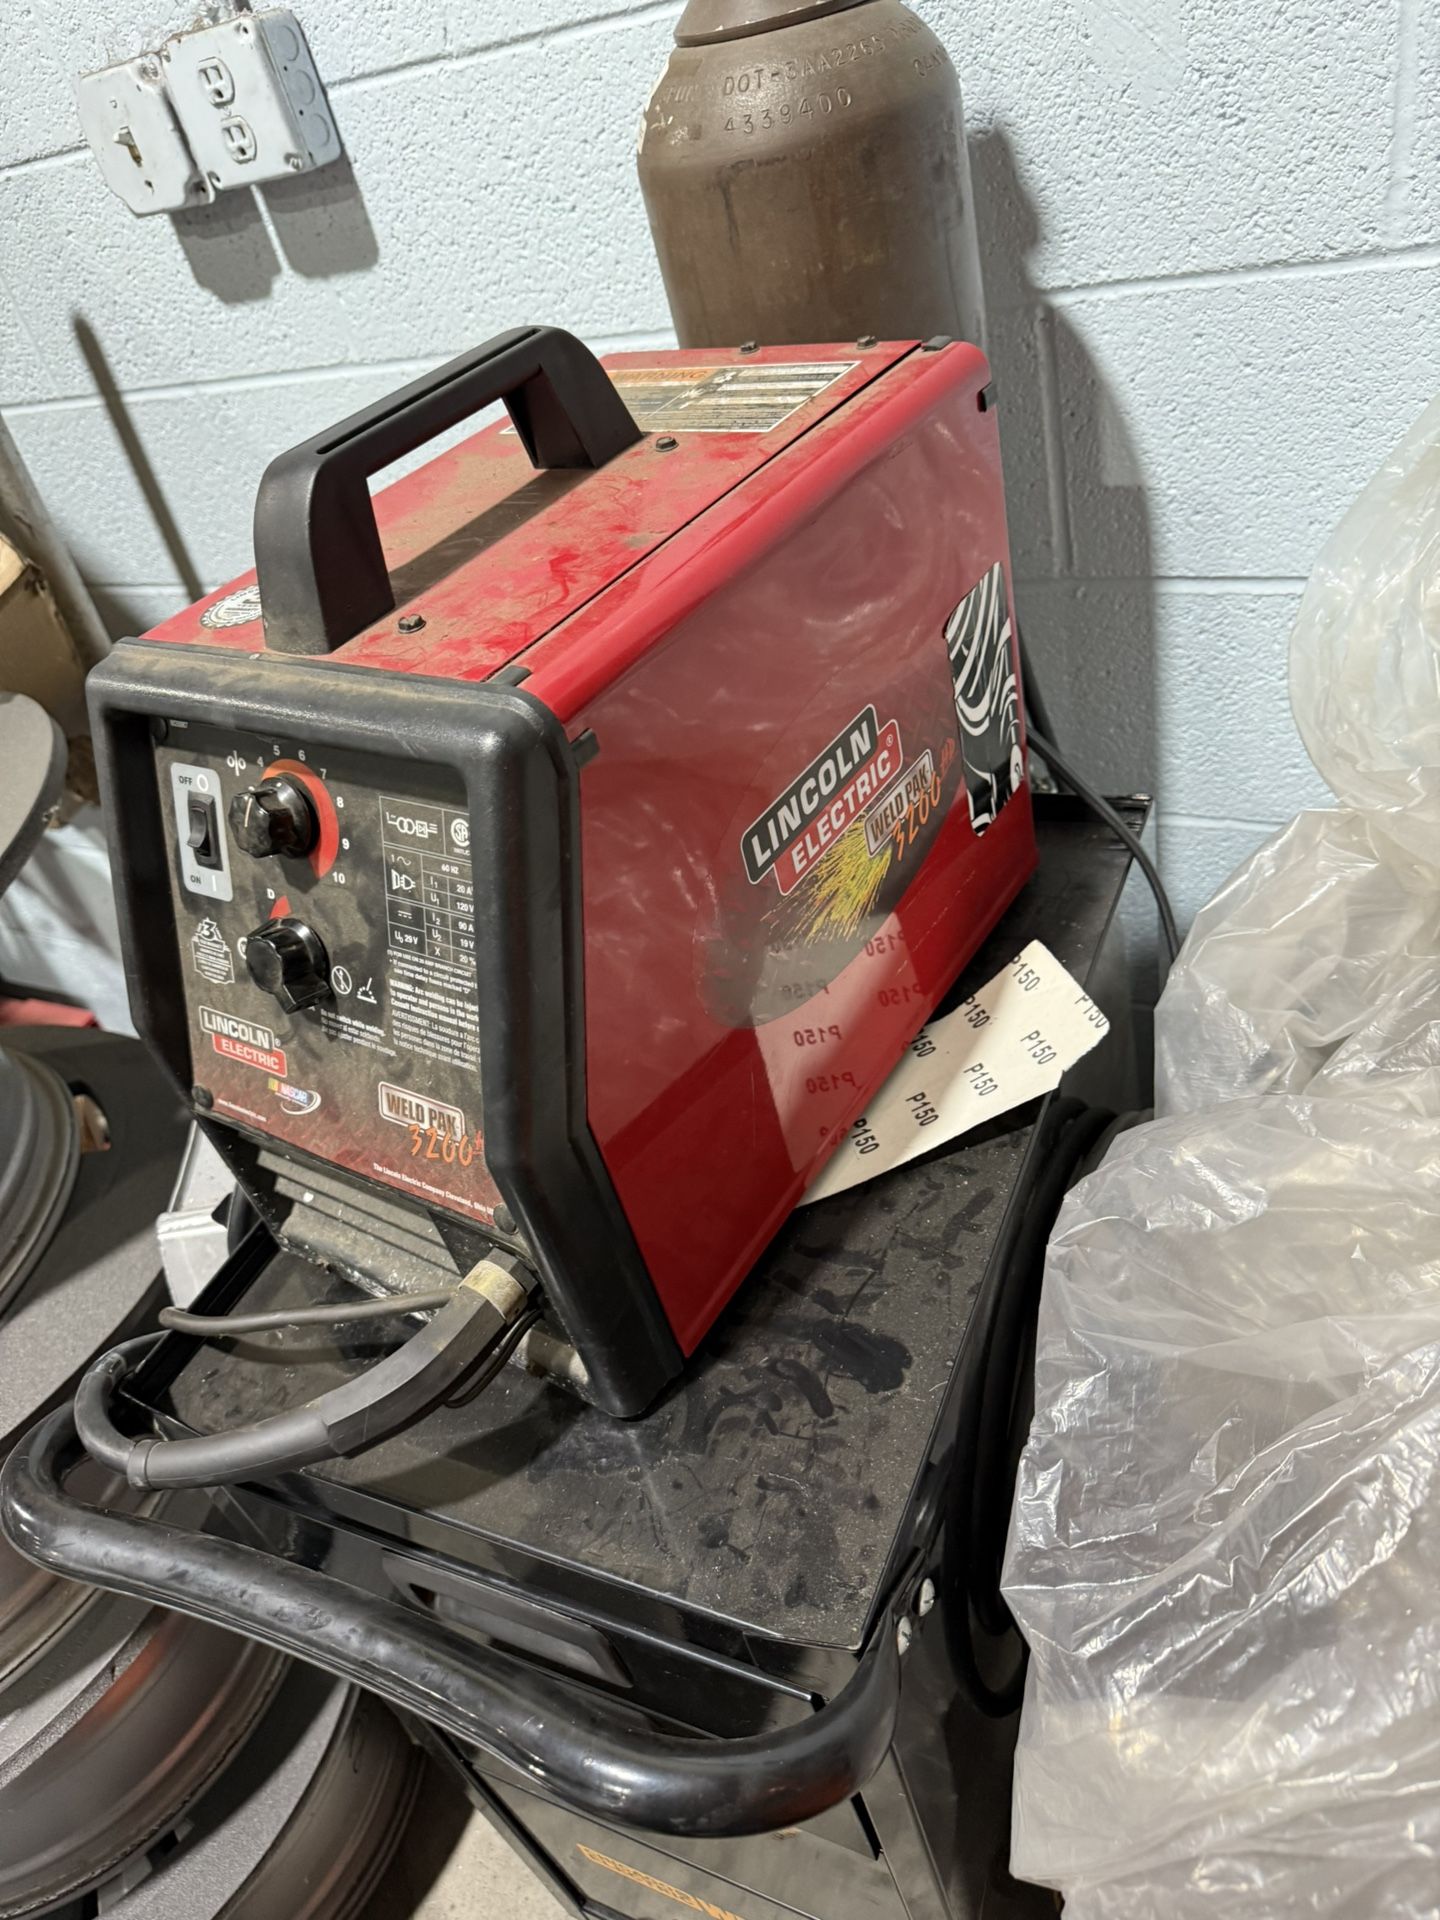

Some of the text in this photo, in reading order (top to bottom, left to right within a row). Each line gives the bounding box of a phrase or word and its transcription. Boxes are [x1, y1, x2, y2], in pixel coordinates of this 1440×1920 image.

[724, 86, 852, 134] 4339400
[273, 745, 280, 756] 5
[298, 750, 306, 761] 6
[257, 756, 264, 768] 4
[320, 768, 327, 780] 7
[178, 775, 192, 786] OFF
[751, 720, 871, 868] LINCOLN
[336, 797, 344, 808] 8
[870, 763, 929, 844] WELD PAK
[791, 750, 891, 874] ELECTRIC
[892, 770, 941, 861] 3200
[342, 838, 350, 850] 9
[441, 864, 450, 873] 60
[190, 874, 202, 885] ON
[332, 871, 346, 885] 10
[456, 884, 465, 894] 20
[456, 901, 475, 913] 120 V
[458, 921, 474, 932] 90 A
[460, 938, 475, 949] 19 V
[434, 946, 440, 956] X
[459, 954, 469, 964] 20
[203, 1011, 270, 1050] LINCOLN
[1021, 1030, 1057, 1065] P150
[221, 1038, 279, 1070] ELECTRIC
[964, 1063, 998, 1097] P150
[385, 1092, 457, 1137] WELD PAK
[905, 1092, 939, 1127] P150
[852, 1118, 880, 1155] P150
[408, 1123, 473, 1167] 3200
